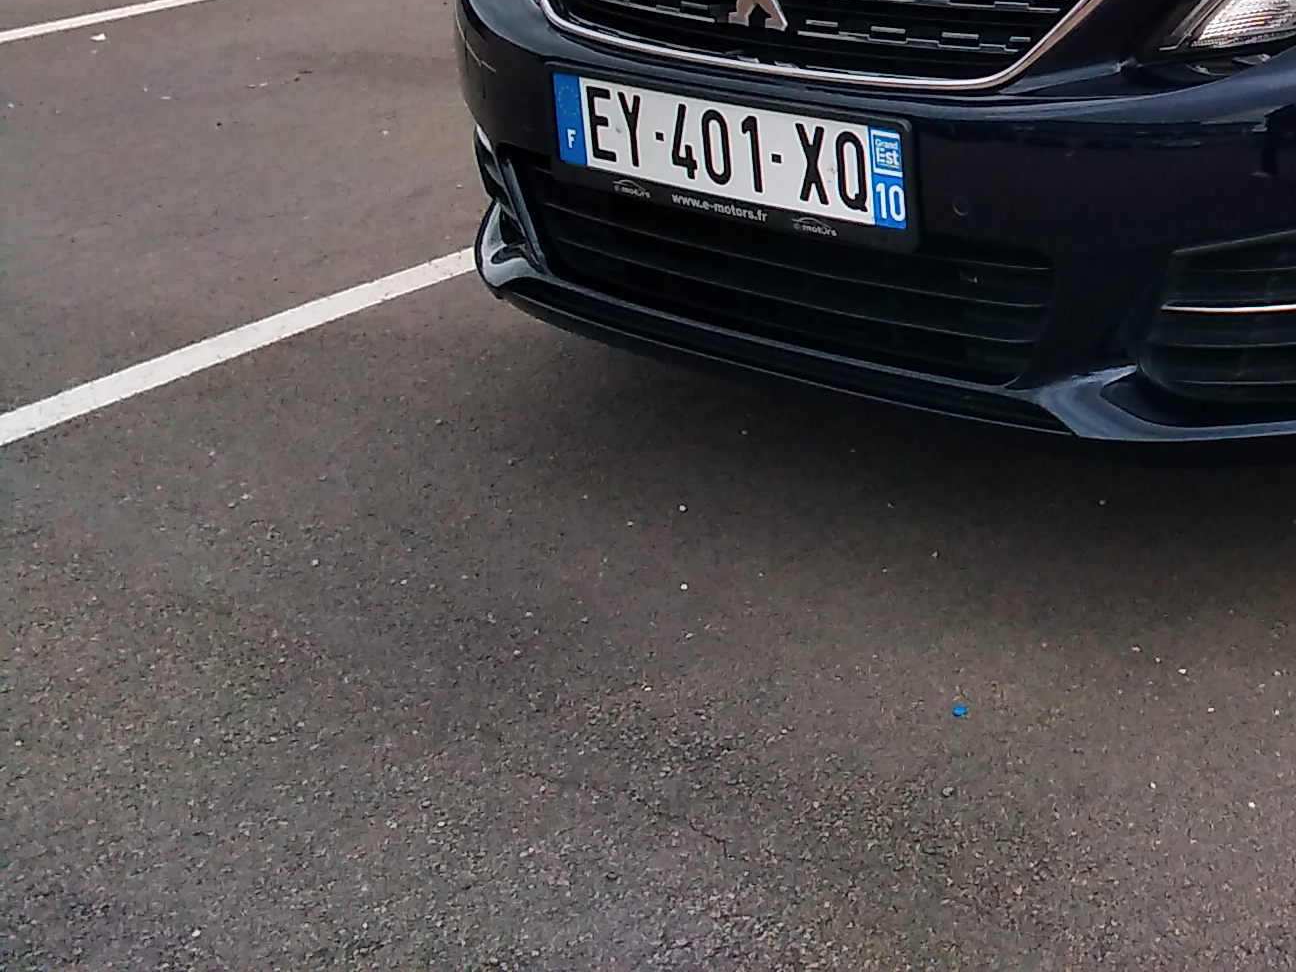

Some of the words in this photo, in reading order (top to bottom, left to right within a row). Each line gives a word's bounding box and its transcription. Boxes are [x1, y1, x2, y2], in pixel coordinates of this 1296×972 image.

[567, 129, 577, 148] F
[585, 85, 868, 212] EY-401-XQ
[875, 138, 899, 150] Grand
[876, 148, 899, 166] Est
[671, 193, 768, 222] www.e-motors.fr
[876, 182, 906, 222] 10
